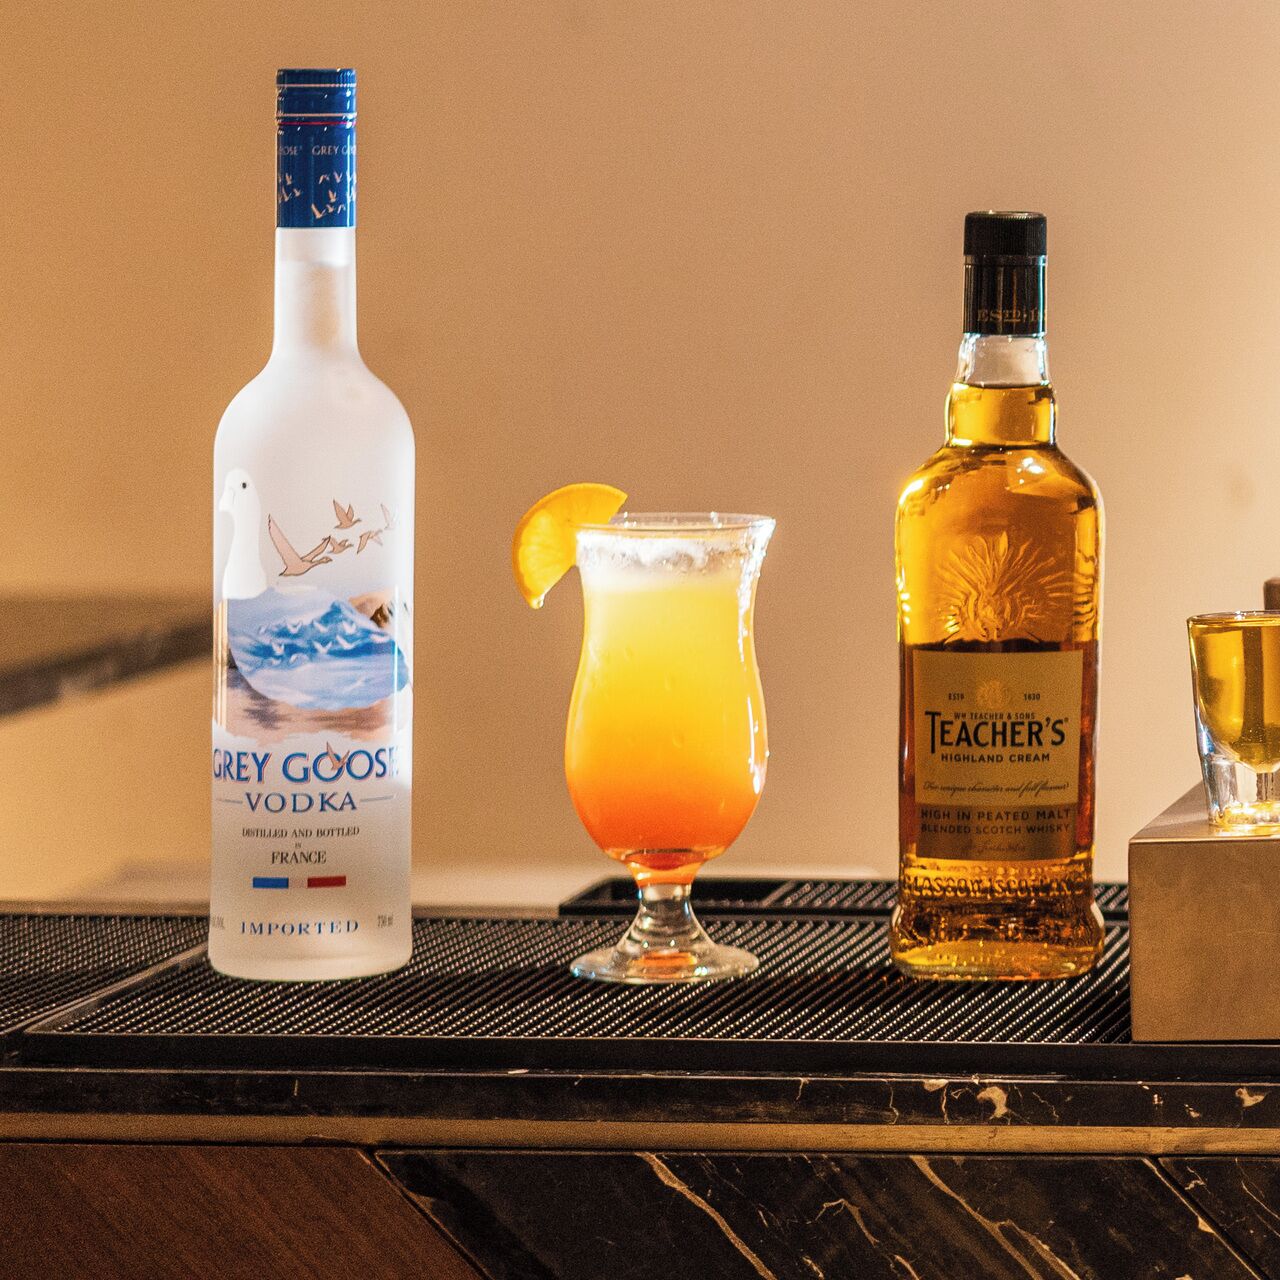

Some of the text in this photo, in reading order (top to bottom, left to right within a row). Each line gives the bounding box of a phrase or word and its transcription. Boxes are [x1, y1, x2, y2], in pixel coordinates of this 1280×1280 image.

[311, 144, 339, 156] GREY
[970, 712, 1004, 720] TEACHER
[1015, 712, 1035, 720] SONS
[924, 710, 1066, 754] TEACHER'S
[941, 753, 1050, 763] HIGHLAND CREAM
[213, 748, 272, 784] GREY
[245, 792, 357, 813] VODKA
[921, 808, 1071, 821] HIGH IN PEATED MALT
[242, 826, 360, 838] DISTILLED AND BOTTLED
[921, 823, 1070, 835] BLENDED SCOTCH WHISKY
[271, 851, 327, 864] FRANCE
[241, 920, 359, 935] IMPORTED
